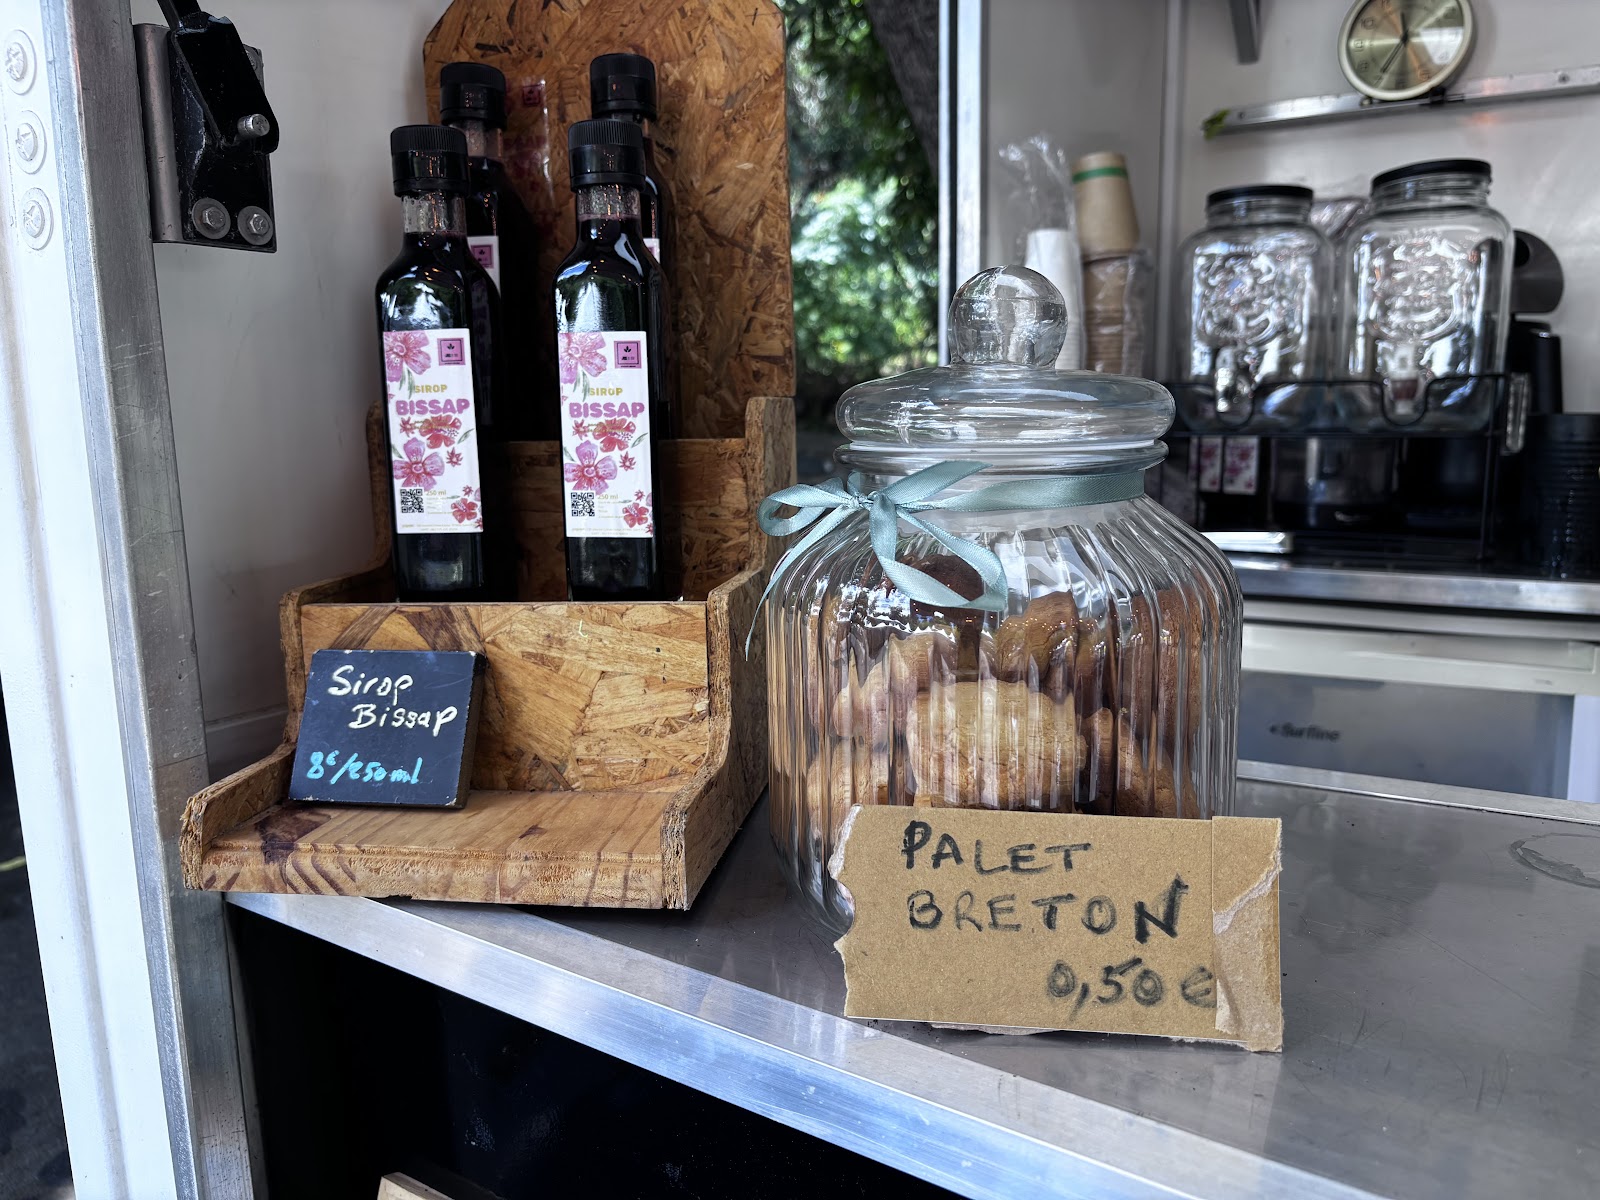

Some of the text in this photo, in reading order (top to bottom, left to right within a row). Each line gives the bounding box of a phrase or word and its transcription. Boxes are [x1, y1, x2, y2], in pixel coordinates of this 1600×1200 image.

[414, 383, 448, 394] SIROP
[588, 387, 623, 397] SIROP
[395, 398, 471, 416] BISSAP
[568, 401, 645, 418] BISSAP
[327, 664, 414, 706] Sirop
[348, 703, 458, 737] Bissap
[901, 820, 1092, 876] PALET
[907, 874, 1190, 944] BRETON
